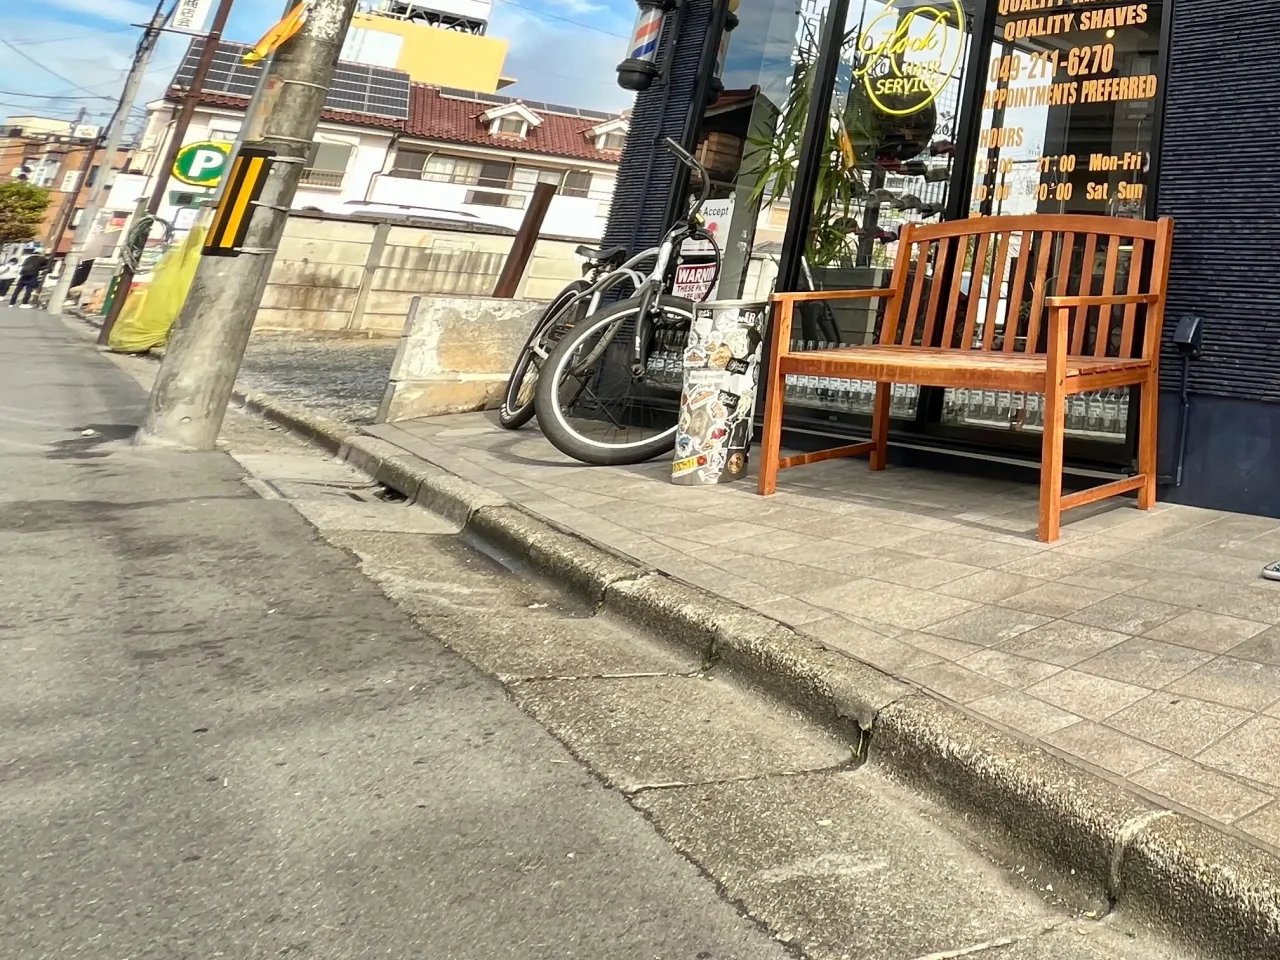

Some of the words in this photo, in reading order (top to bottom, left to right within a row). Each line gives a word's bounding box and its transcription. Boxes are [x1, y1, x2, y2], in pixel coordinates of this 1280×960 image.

[1003, 13, 1075, 42] QUALITY
[1080, 3, 1148, 32] SHAVES
[990, 43, 1115, 83] 049-211-6270
[875, 76, 939, 95] SERVICE
[982, 81, 1078, 110] APPOINTMENTS
[1080, 74, 1158, 104] PREFERRED
[979, 127, 1025, 149] HOURS
[187, 149, 224, 177] P
[1036, 154, 1076, 173] 21:00
[1088, 151, 1142, 172] Mon-Fri
[1032, 182, 1073, 201] 20:00
[1117, 180, 1144, 200] Sun
[704, 206, 729, 218] Accept
[677, 267, 717, 283] WARNIN
